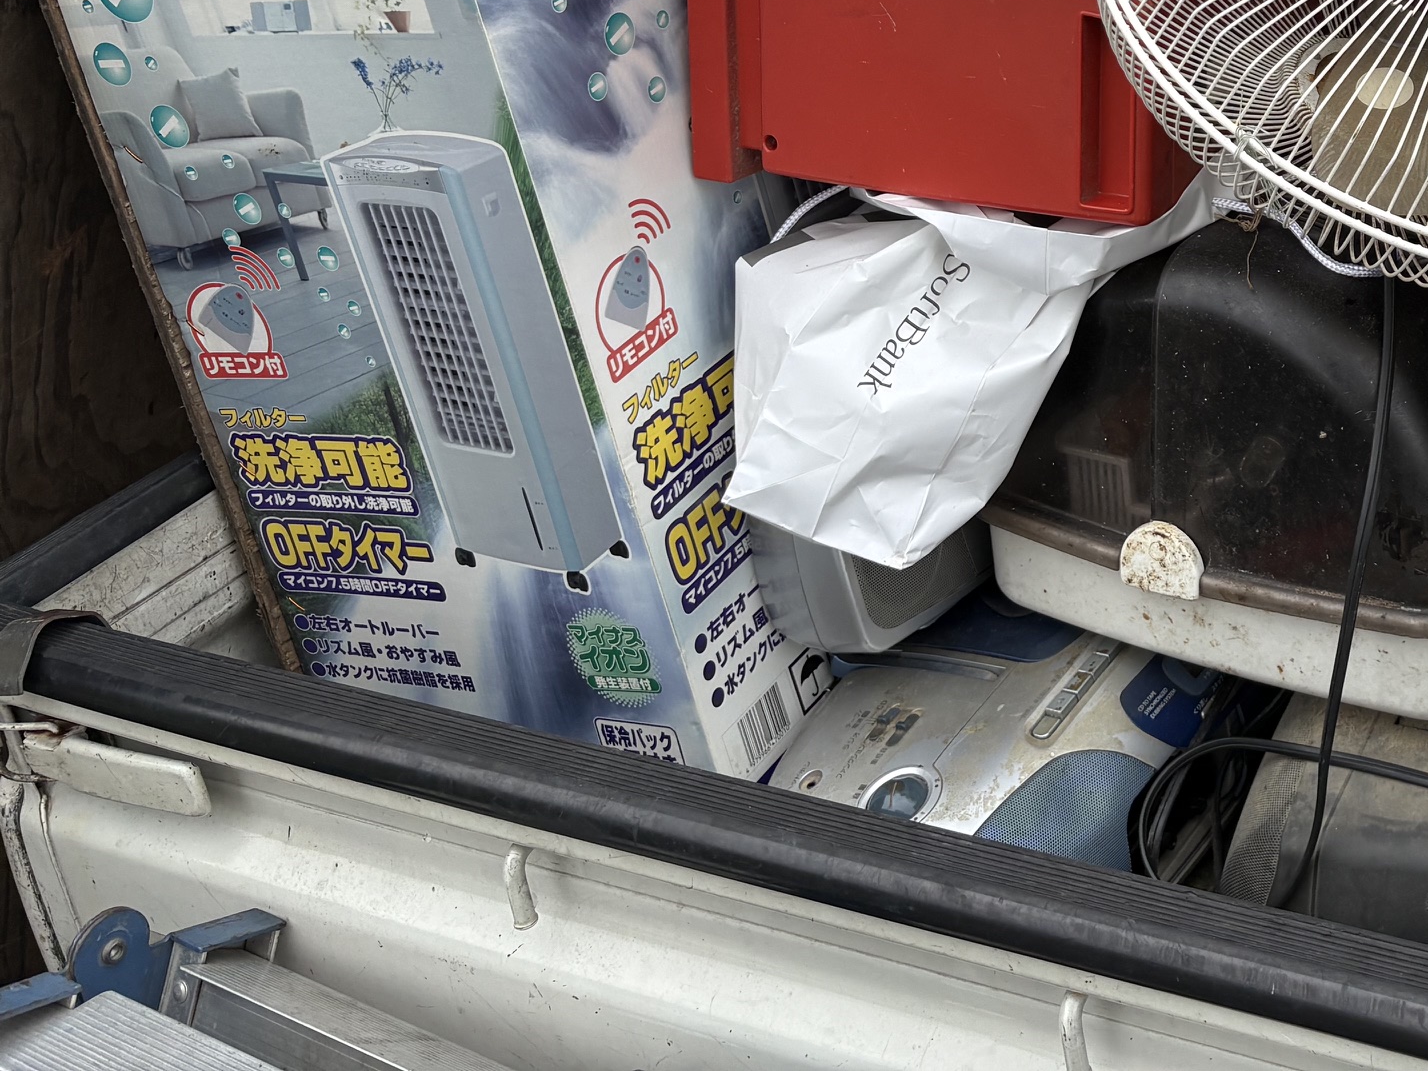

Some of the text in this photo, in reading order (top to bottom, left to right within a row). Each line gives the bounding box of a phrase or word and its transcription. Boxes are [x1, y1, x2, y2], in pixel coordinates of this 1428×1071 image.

[857, 252, 972, 396] SoftBank
[609, 314, 675, 376] リモコン付
[202, 355, 283, 376] リモコン付
[622, 351, 699, 425] フィルター
[218, 407, 307, 428] フィルター
[231, 433, 409, 490] 洗浄可能
[251, 493, 414, 514] フィルターの取り外し洗浄可能
[265, 521, 431, 573] OFFタイマー
[283, 574, 442, 596] マイコン7.5時間OFFタイマー
[308, 614, 440, 638] 左右オートルーバー
[567, 624, 644, 646] マイナス
[318, 638, 462, 668] リズム風・おやすみ風
[580, 646, 650, 673] イオン
[326, 663, 476, 693] 水タンクに抗菌樹脂を採用
[594, 676, 652, 691] 発生装置付
[602, 724, 672, 752] 保冷パック
